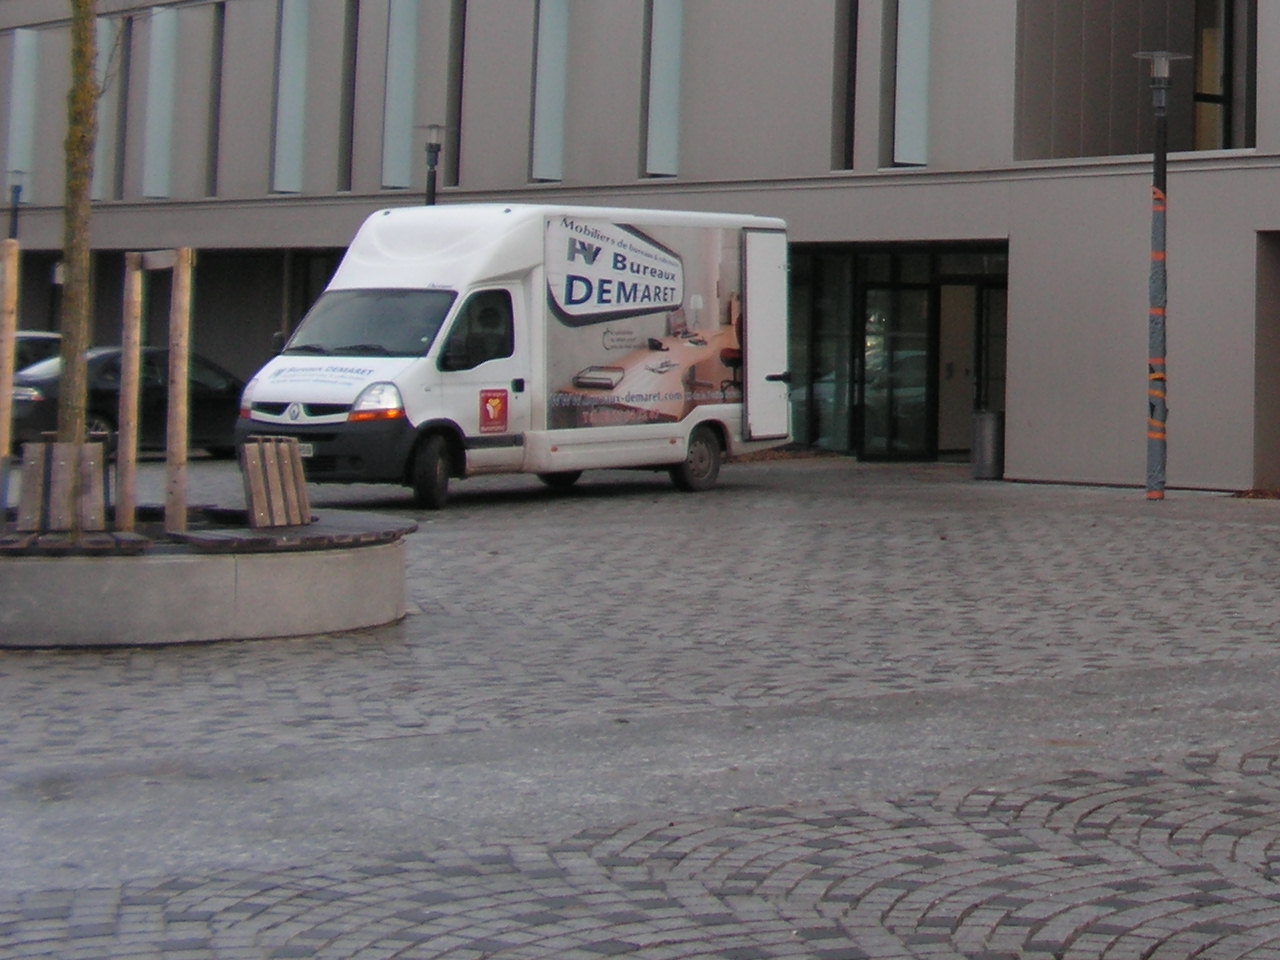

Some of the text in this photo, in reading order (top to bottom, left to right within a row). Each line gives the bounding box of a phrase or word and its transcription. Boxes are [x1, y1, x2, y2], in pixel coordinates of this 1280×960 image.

[560, 217, 615, 246] Mobiliers
[617, 239, 628, 250] de
[612, 253, 675, 281] Bureaux
[565, 275, 676, 305] DEMARET
[324, 366, 375, 376] DEMARET
